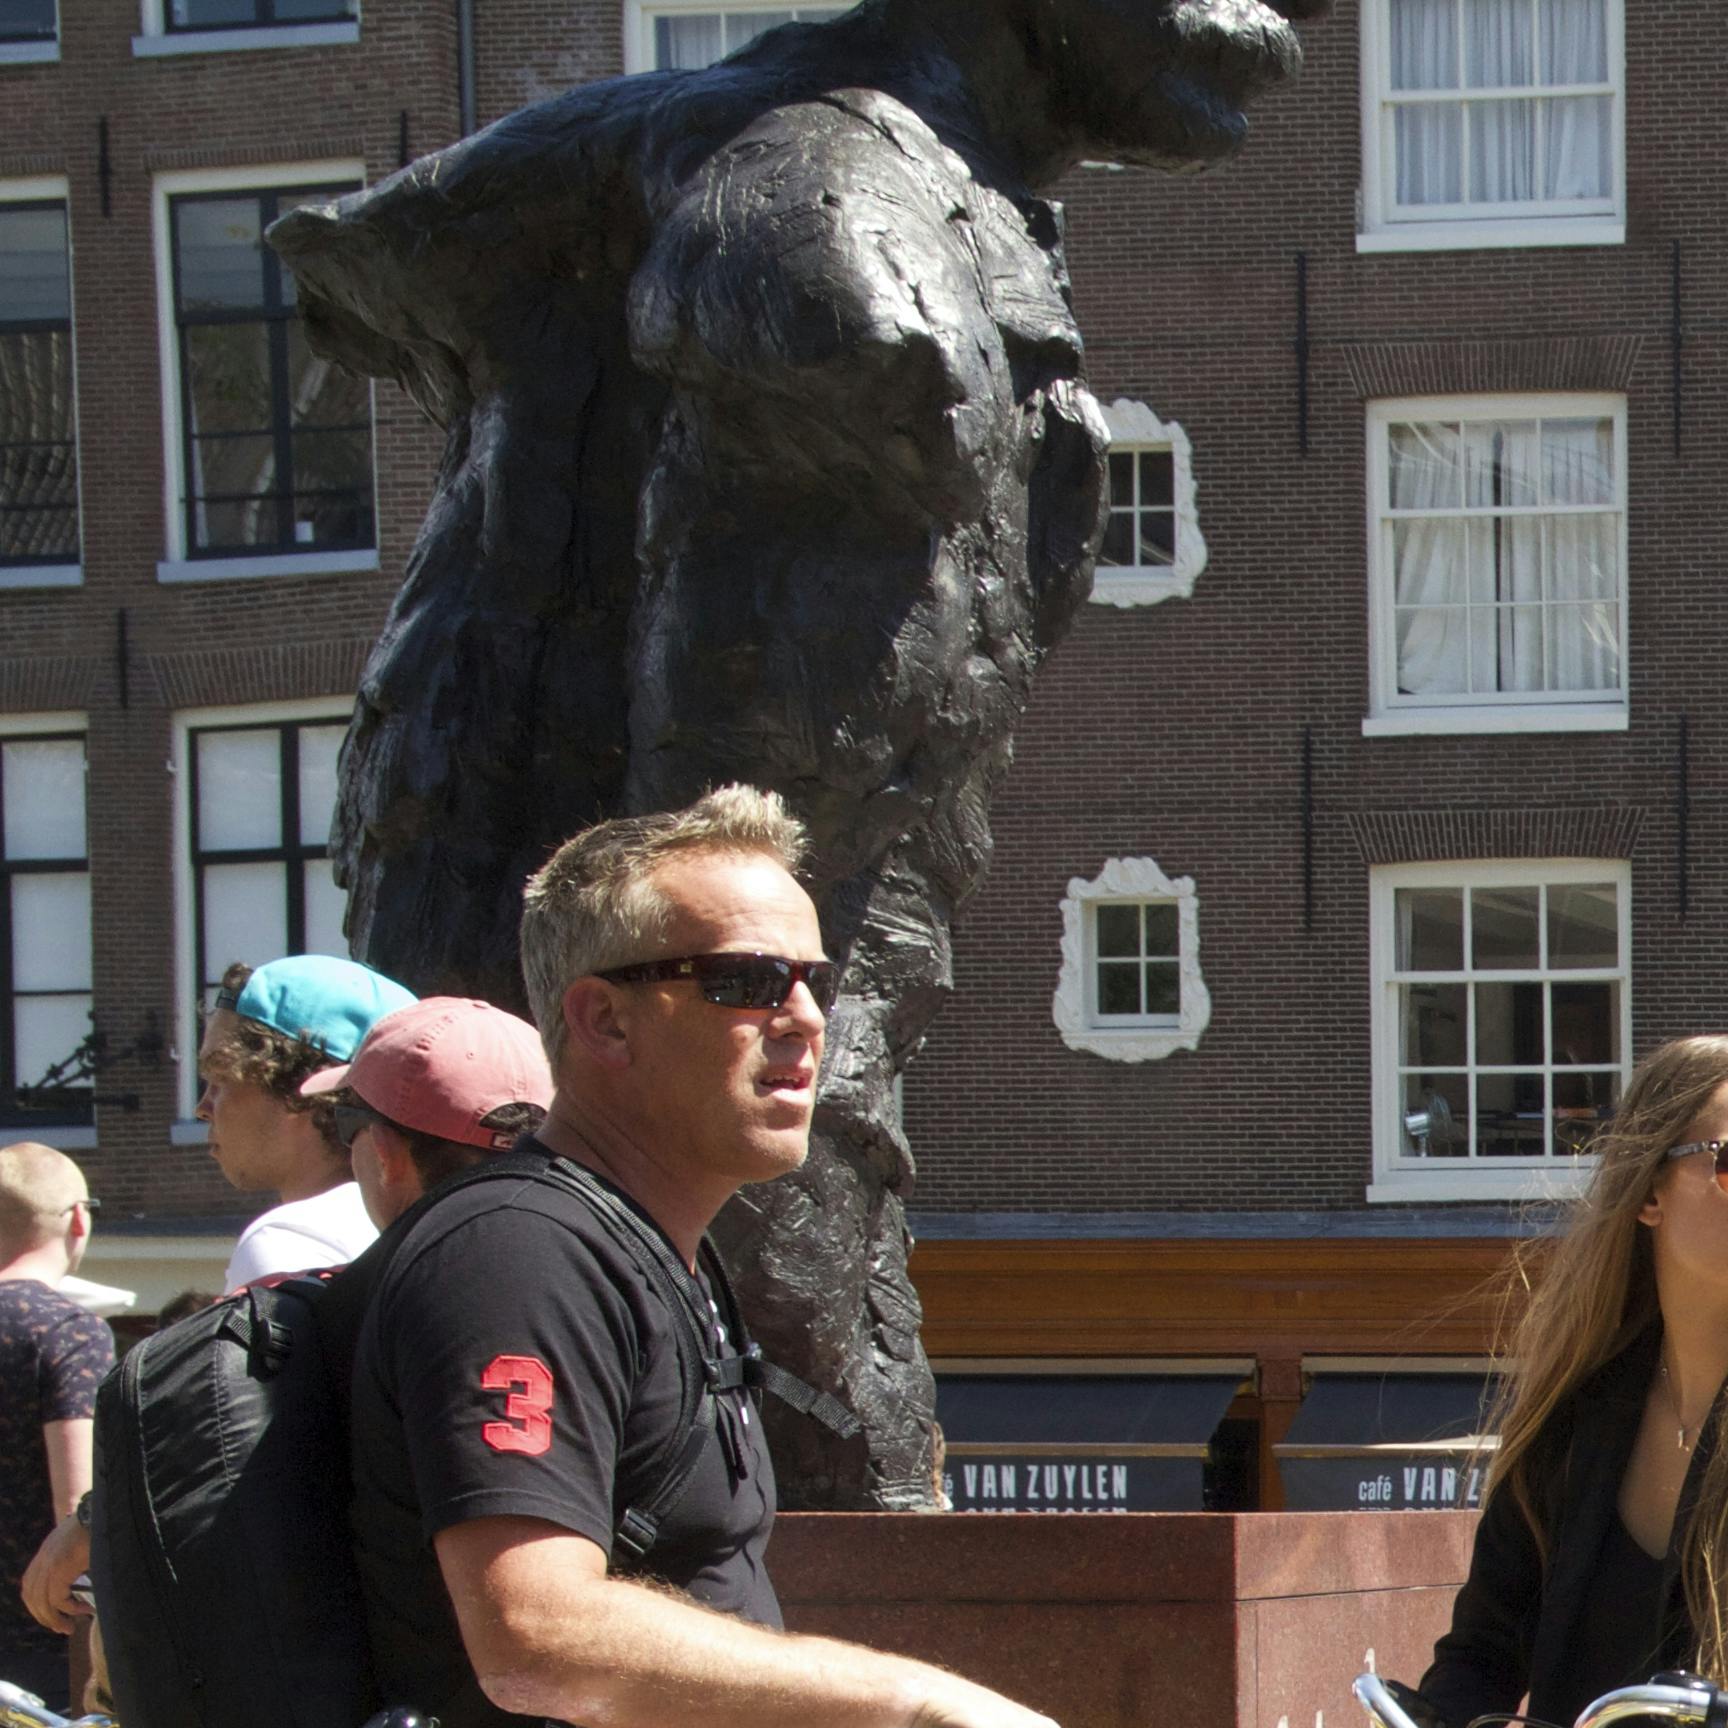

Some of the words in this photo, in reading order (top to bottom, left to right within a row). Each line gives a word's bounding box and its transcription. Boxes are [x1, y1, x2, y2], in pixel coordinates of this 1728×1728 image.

[482, 1355, 553, 1455] 3
[963, 1464, 1016, 1499] VAN
[1026, 1465, 1128, 1500] ZUYLEN
[1358, 1474, 1393, 1502] café
[1403, 1467, 1457, 1502] VAN
